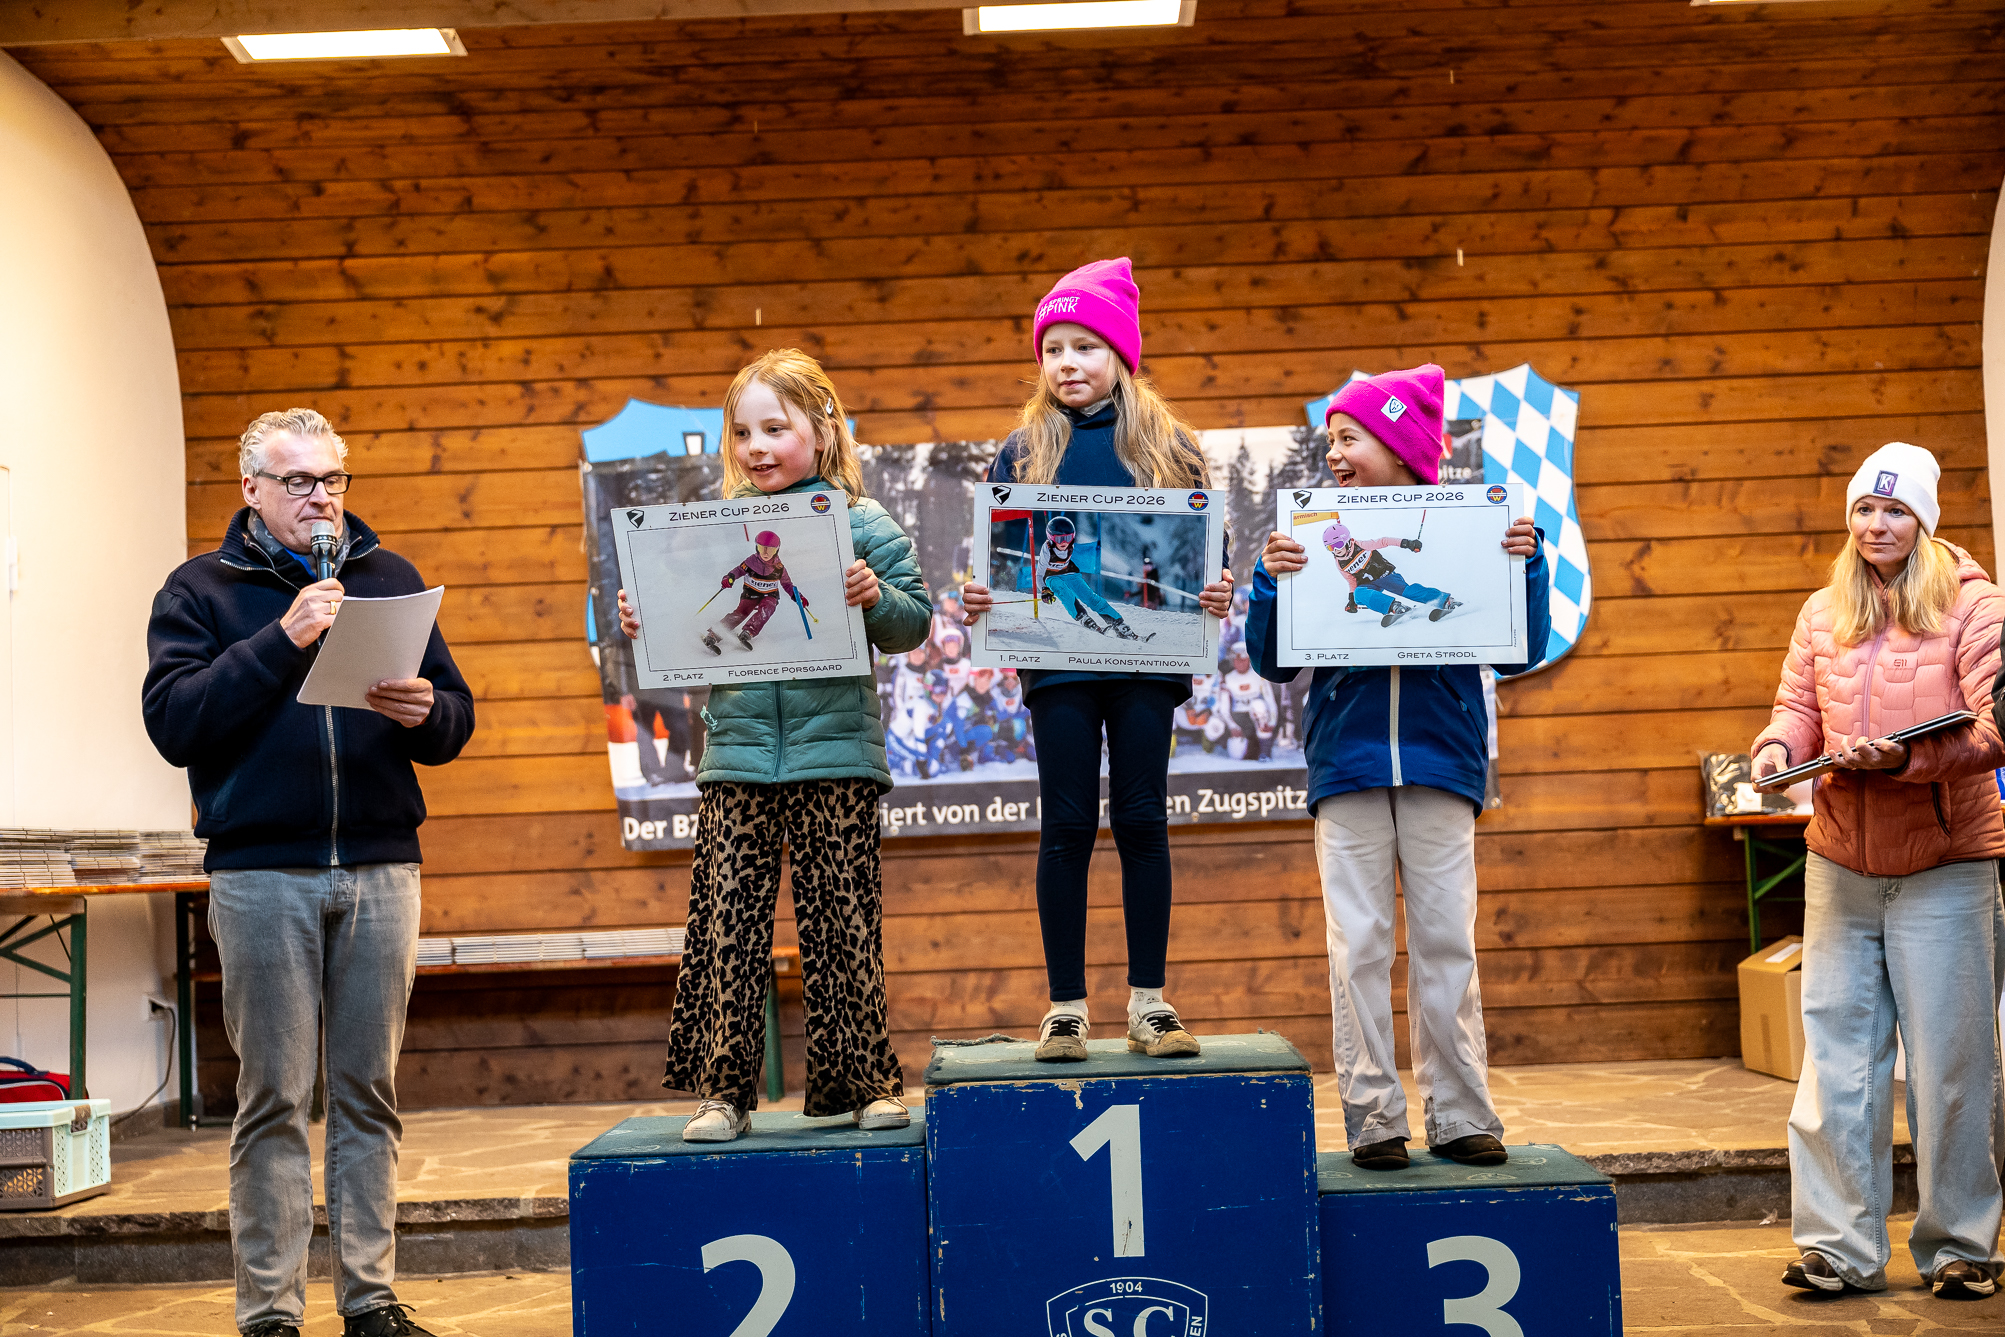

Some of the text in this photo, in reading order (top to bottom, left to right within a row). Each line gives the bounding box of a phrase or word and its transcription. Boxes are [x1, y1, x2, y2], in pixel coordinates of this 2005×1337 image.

[1036, 492, 1166, 506] ZIENER CUP 2026
[1337, 491, 1465, 504] ZIENER CUP 2026
[669, 503, 790, 522] ZIENER CUP 2026
[1008, 654, 1041, 663] PLATZ
[1068, 656, 1103, 665] PAULA
[1304, 653, 1316, 661] 3.
[1317, 652, 1350, 660] PLATZ
[1397, 651, 1433, 659] GRETA
[662, 674, 672, 682] 2.
[674, 672, 704, 681] PLATZ
[728, 668, 780, 678] FLORENCE
[623, 816, 668, 841] Der
[880, 801, 928, 827] iert
[931, 803, 977, 825] von
[985, 796, 1031, 823] der
[1196, 786, 1308, 819] Zugspitz
[1069, 1104, 1143, 1258] 1
[700, 1234, 797, 1337] 2
[1109, 1281, 1143, 1294] 1904
[1427, 1236, 1522, 1337] 3
